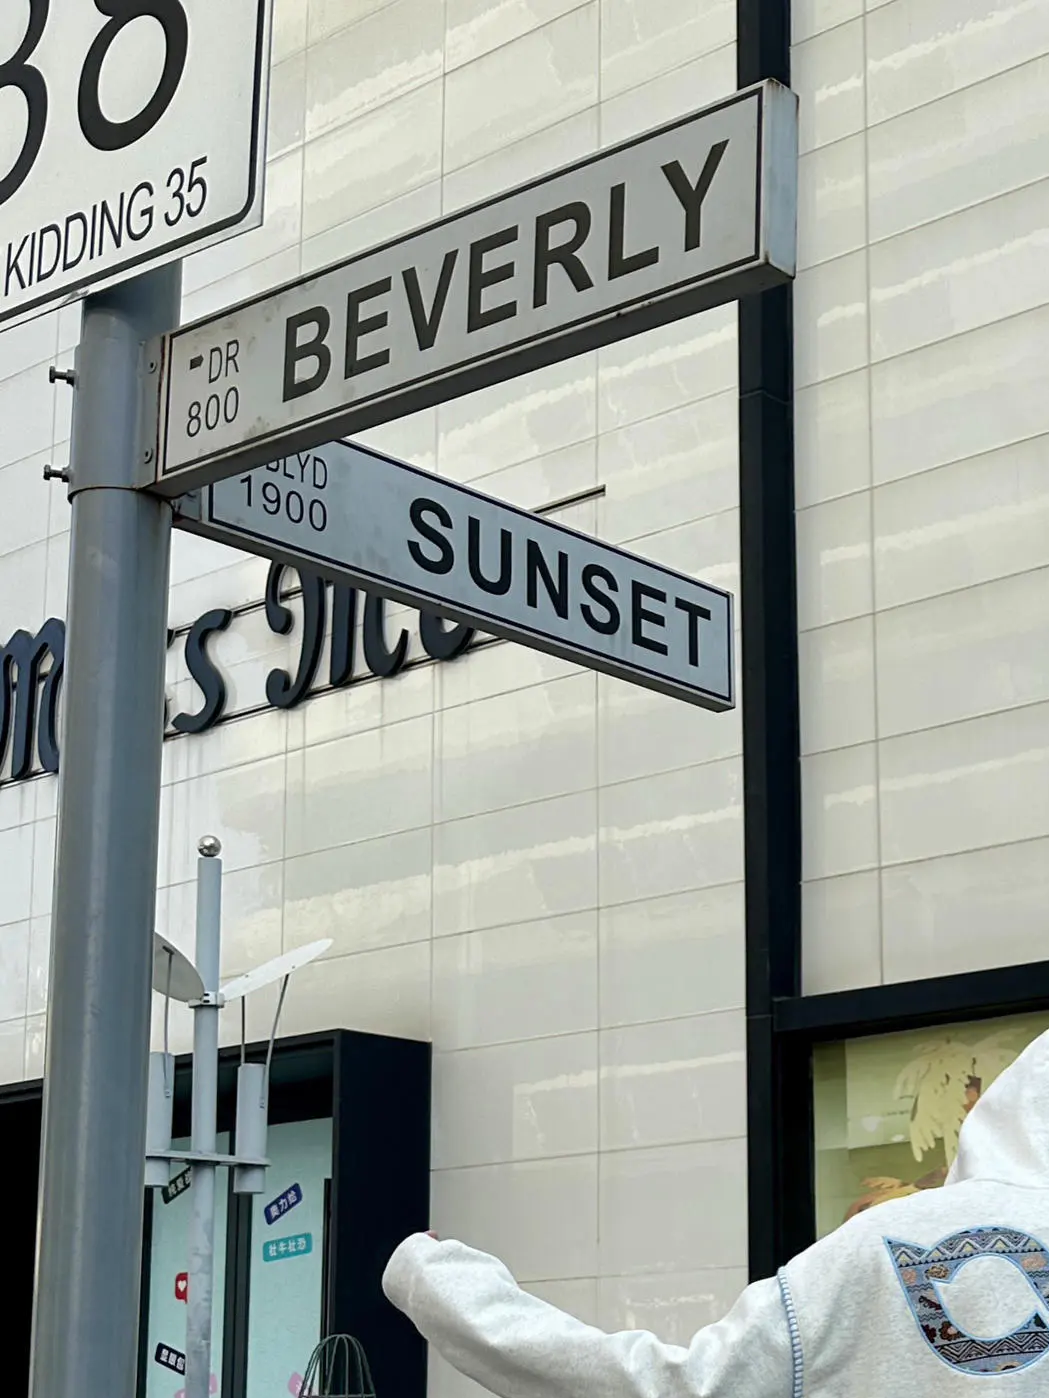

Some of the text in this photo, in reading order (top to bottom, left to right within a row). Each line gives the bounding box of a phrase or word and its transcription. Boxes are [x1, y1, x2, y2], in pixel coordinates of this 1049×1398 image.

[4, 155, 208, 297] KIDDING 35
[283, 138, 731, 403] BEVERLY
[208, 338, 240, 384] DR
[186, 386, 240, 438] 800
[240, 474, 328, 532] 1900
[406, 496, 712, 668] SUNSET
